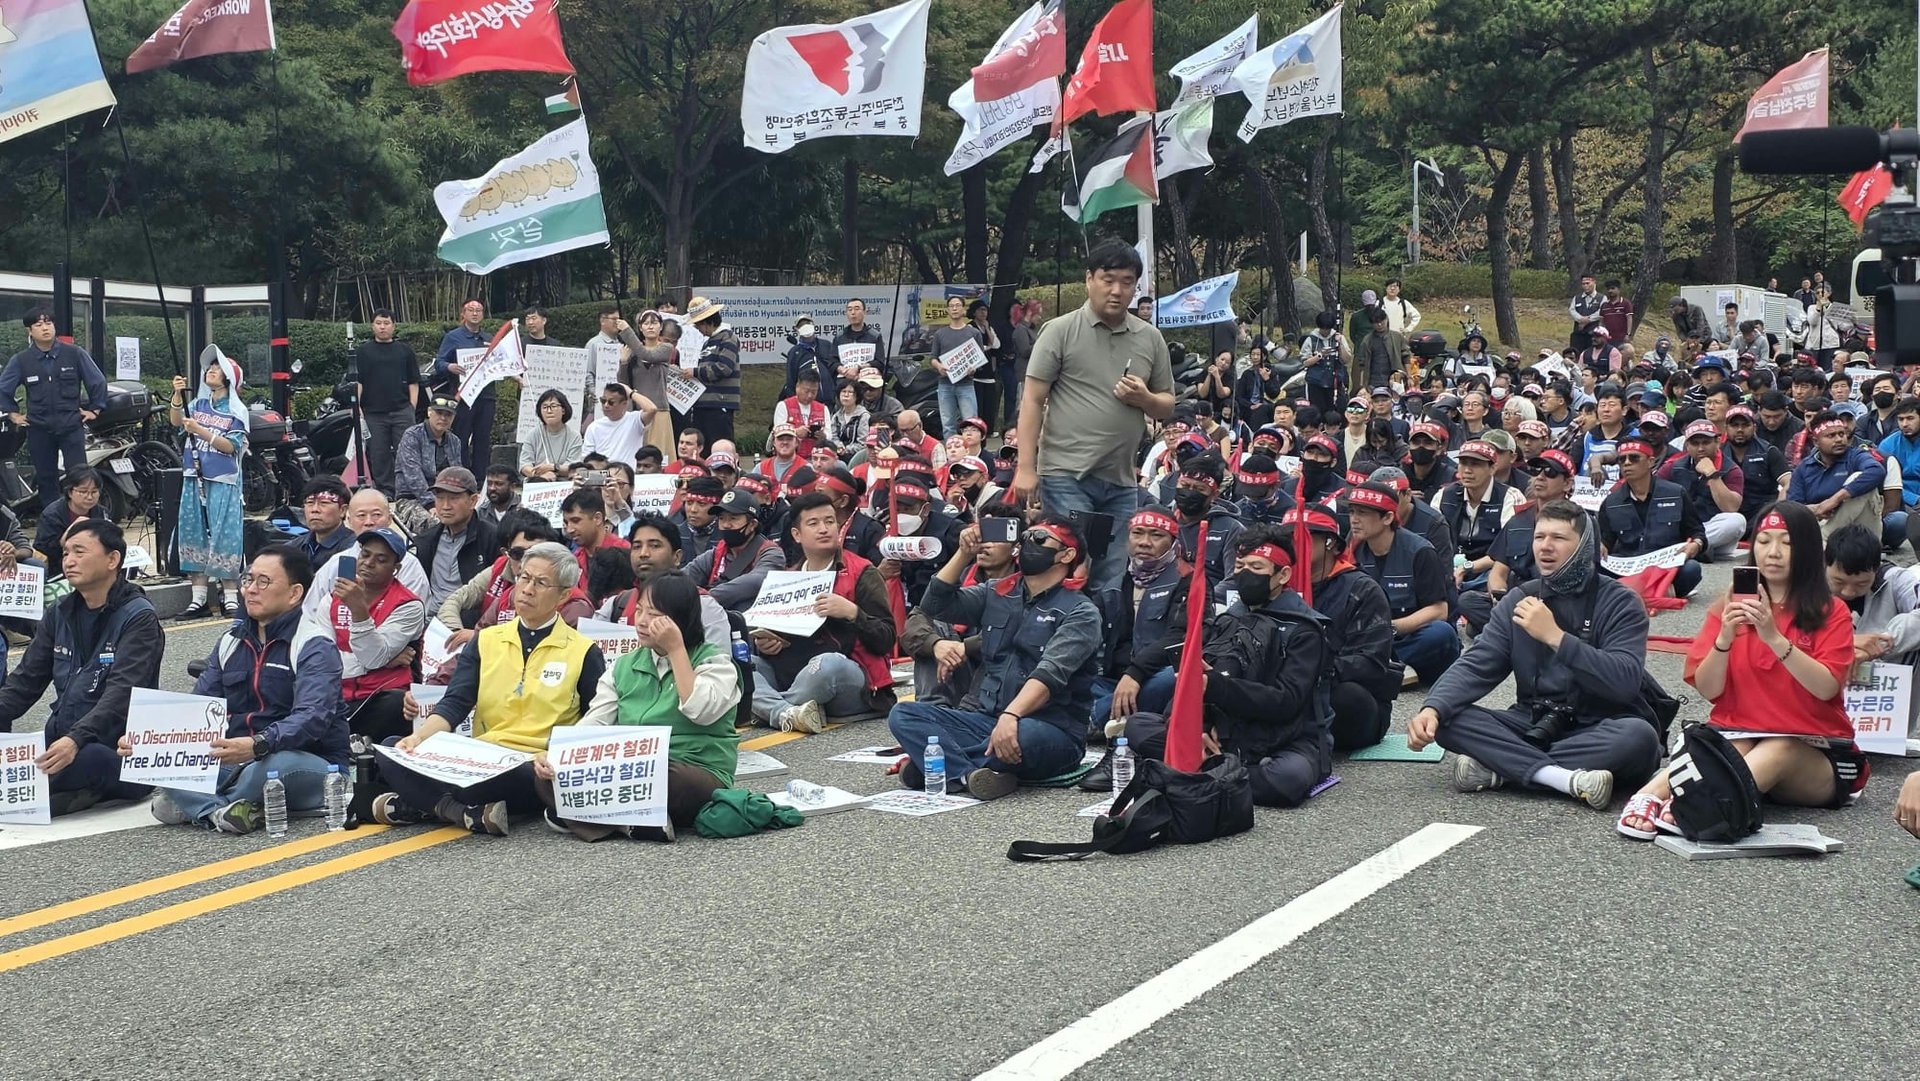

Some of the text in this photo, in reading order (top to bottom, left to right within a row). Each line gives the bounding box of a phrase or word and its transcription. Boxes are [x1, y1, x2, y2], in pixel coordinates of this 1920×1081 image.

[749, 310, 760, 318] HD
[761, 309, 791, 319] Hyundai
[814, 308, 846, 316] Industrie
[732, 325, 767, 338] 대중공업
[738, 341, 775, 353] 지합니다!
[636, 498, 650, 508] Job
[15, 596, 36, 606] 중단!
[793, 587, 810, 600] Job
[594, 639, 617, 654] 계약
[127, 727, 222, 746] No Discrimination!
[6, 745, 36, 762] 철회!
[559, 737, 660, 766] 나쁜계약 철회!
[123, 754, 149, 769] Free
[151, 752, 172, 768] Job
[6, 765, 35, 783] 철회!
[557, 760, 656, 788] 임금삭감 철회!
[7, 785, 36, 804] 중단!
[561, 783, 653, 808] 차별처우 중단!
